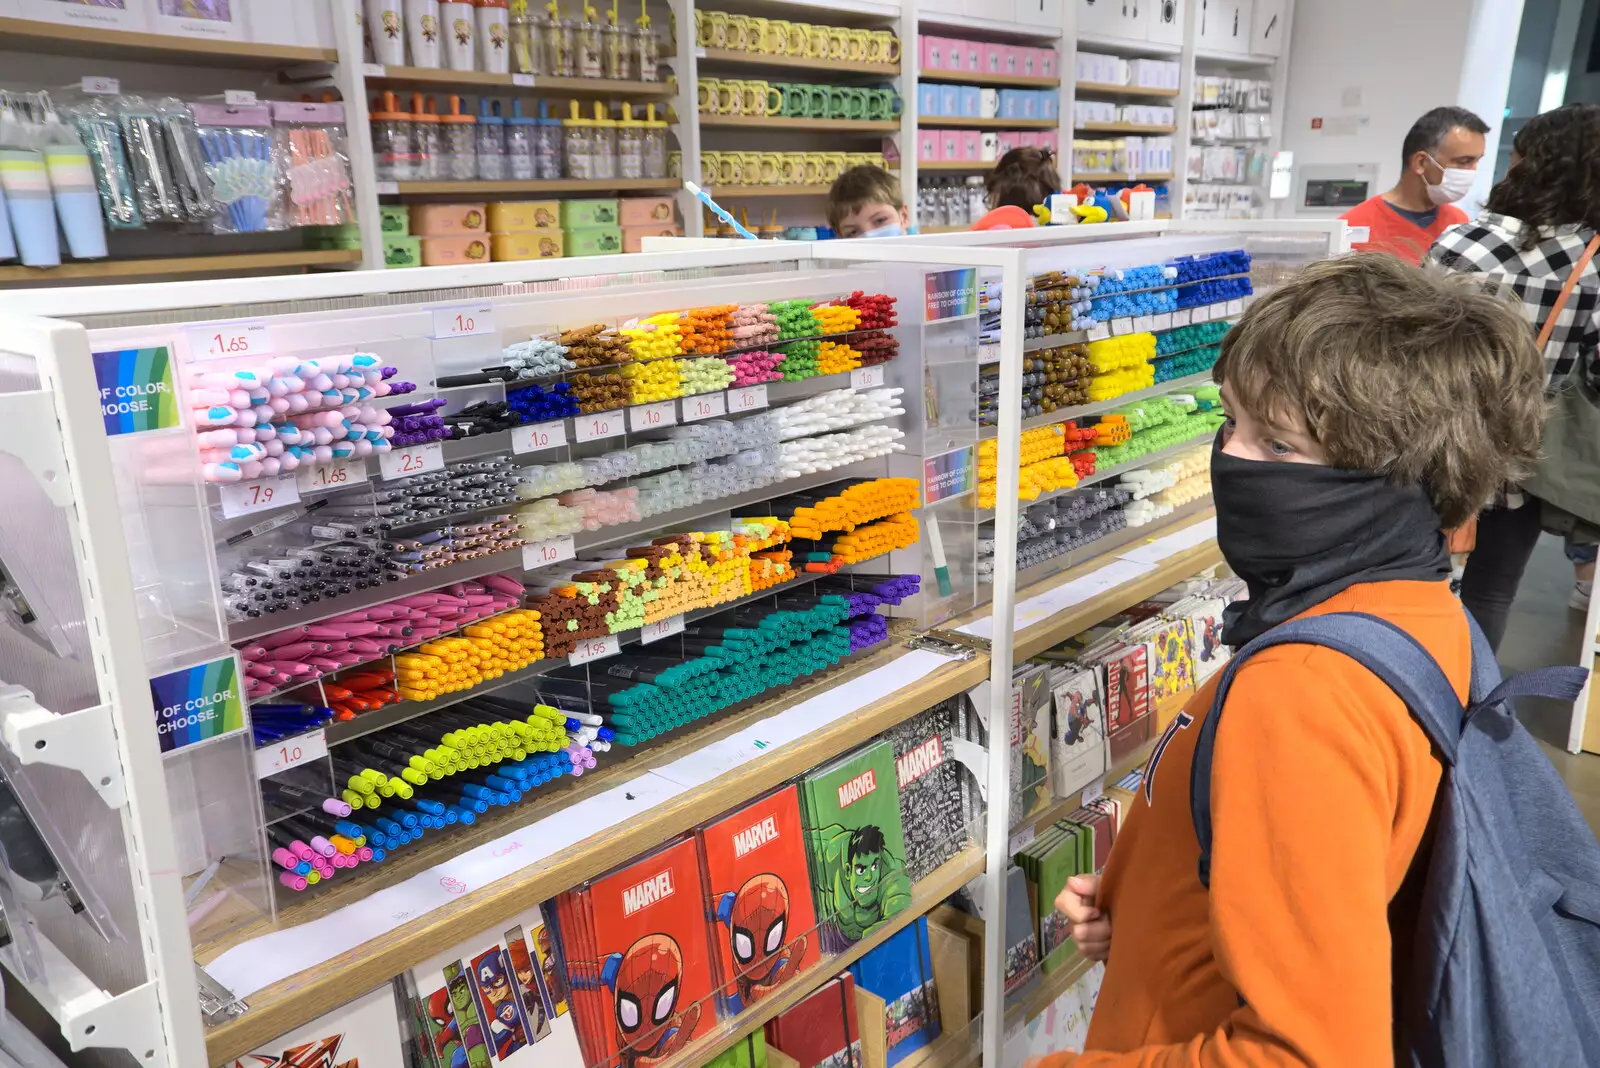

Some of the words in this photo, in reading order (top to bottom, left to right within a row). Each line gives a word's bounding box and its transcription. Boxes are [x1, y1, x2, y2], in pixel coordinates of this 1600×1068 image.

[99, 388, 111, 400] F
[157, 709, 219, 735] CHOOSE.
[162, 704, 181, 718] OF
[898, 738, 942, 788] MARVEL
[838, 770, 877, 808] MARVEL
[733, 816, 778, 858] MARVEL
[623, 871, 674, 915] MARVEL
